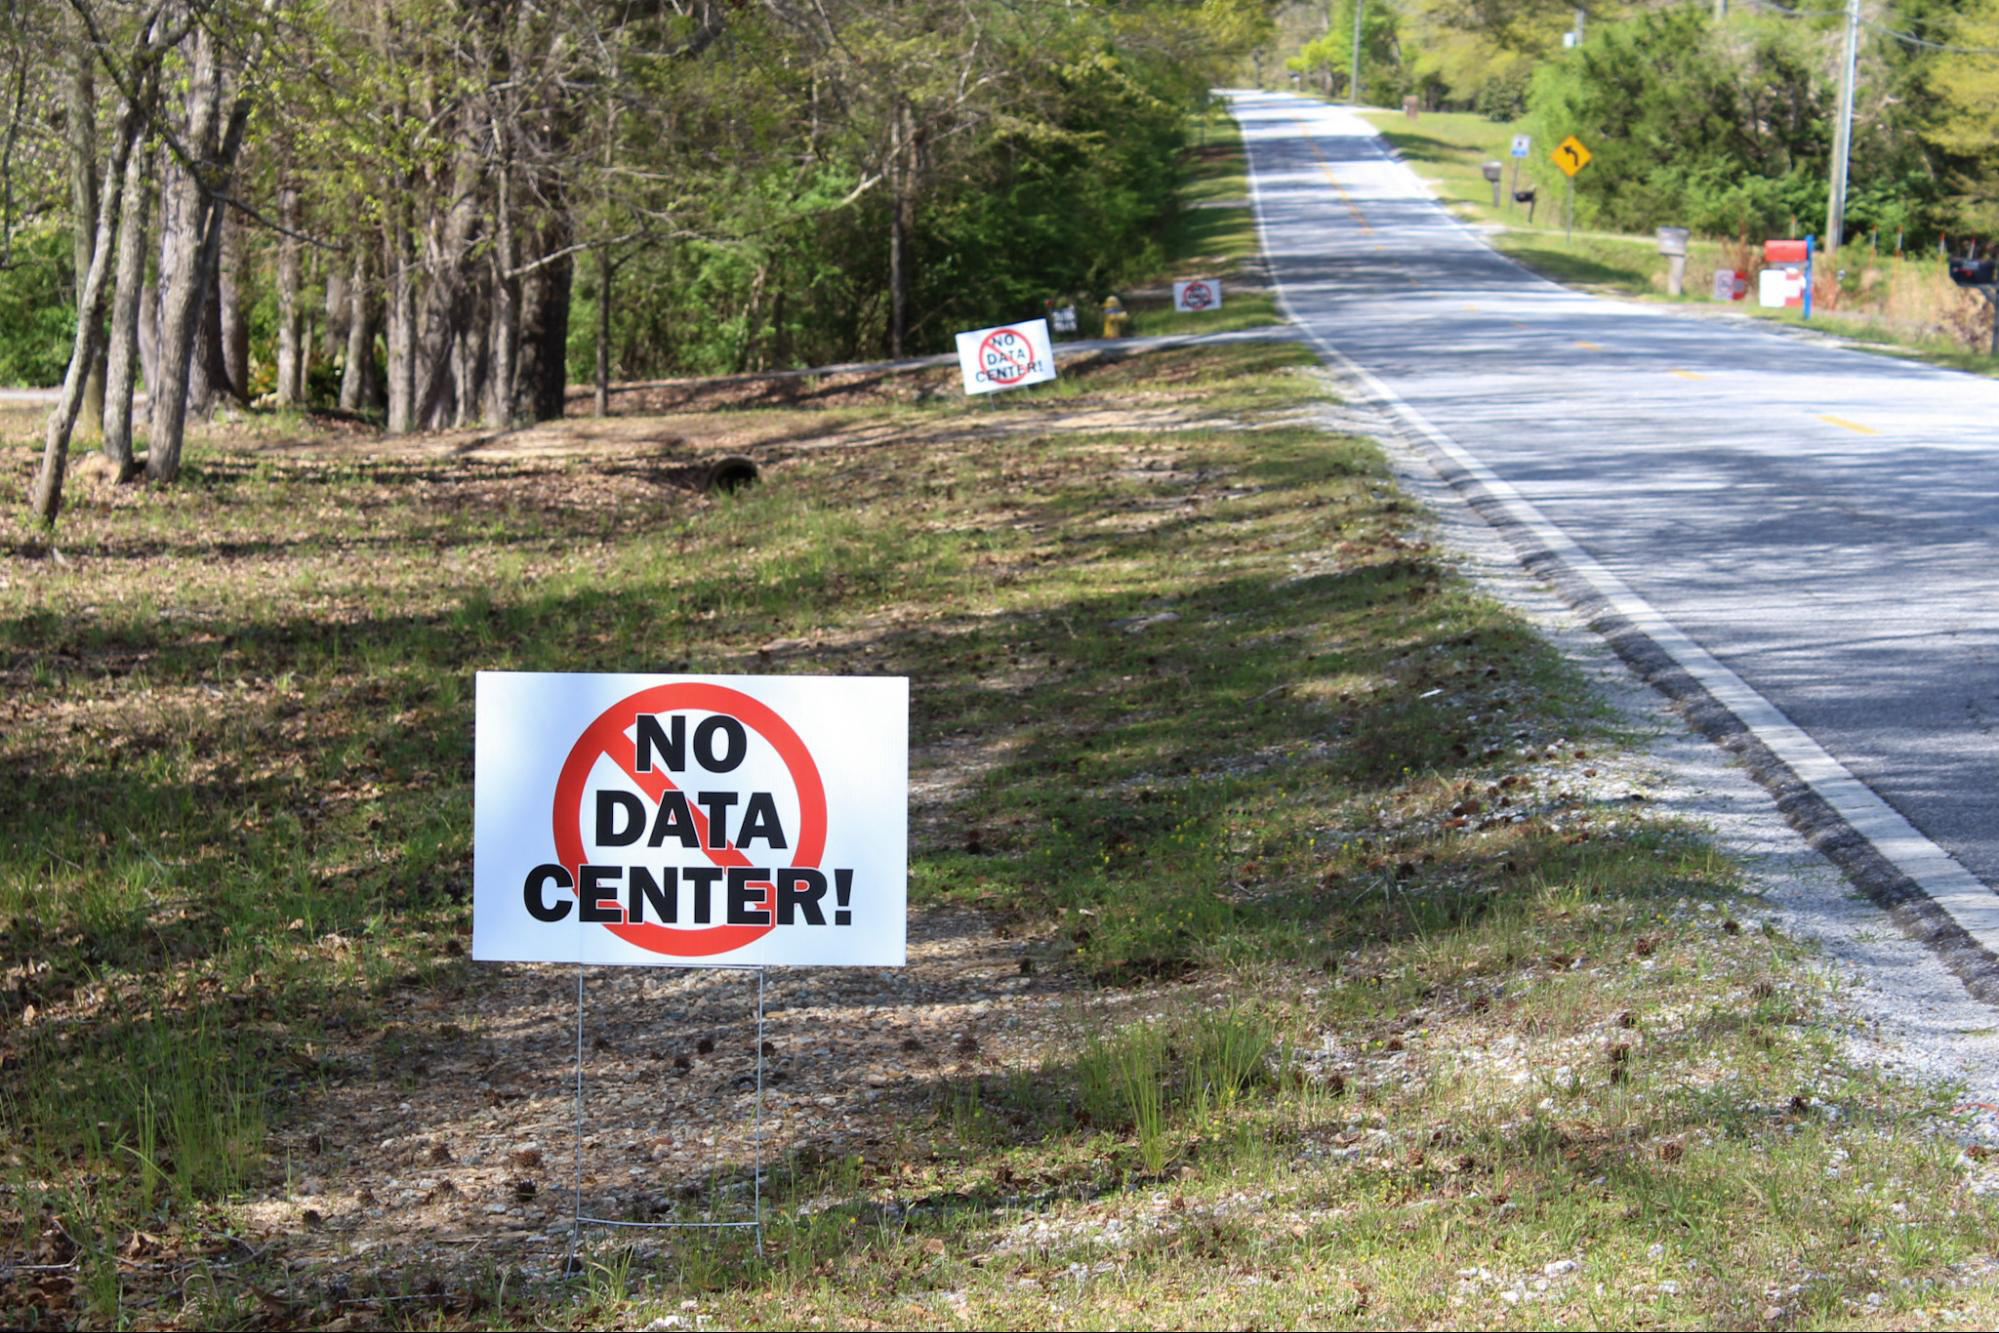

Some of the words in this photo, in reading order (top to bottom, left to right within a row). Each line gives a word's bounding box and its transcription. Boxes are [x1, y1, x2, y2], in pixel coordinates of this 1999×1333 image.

[987, 349, 1025, 365] DATA
[992, 333, 1015, 346] NO
[976, 360, 1044, 382] CENTER!
[636, 714, 747, 773] NO
[595, 790, 788, 849] DATA
[523, 864, 854, 926] CENTER!
